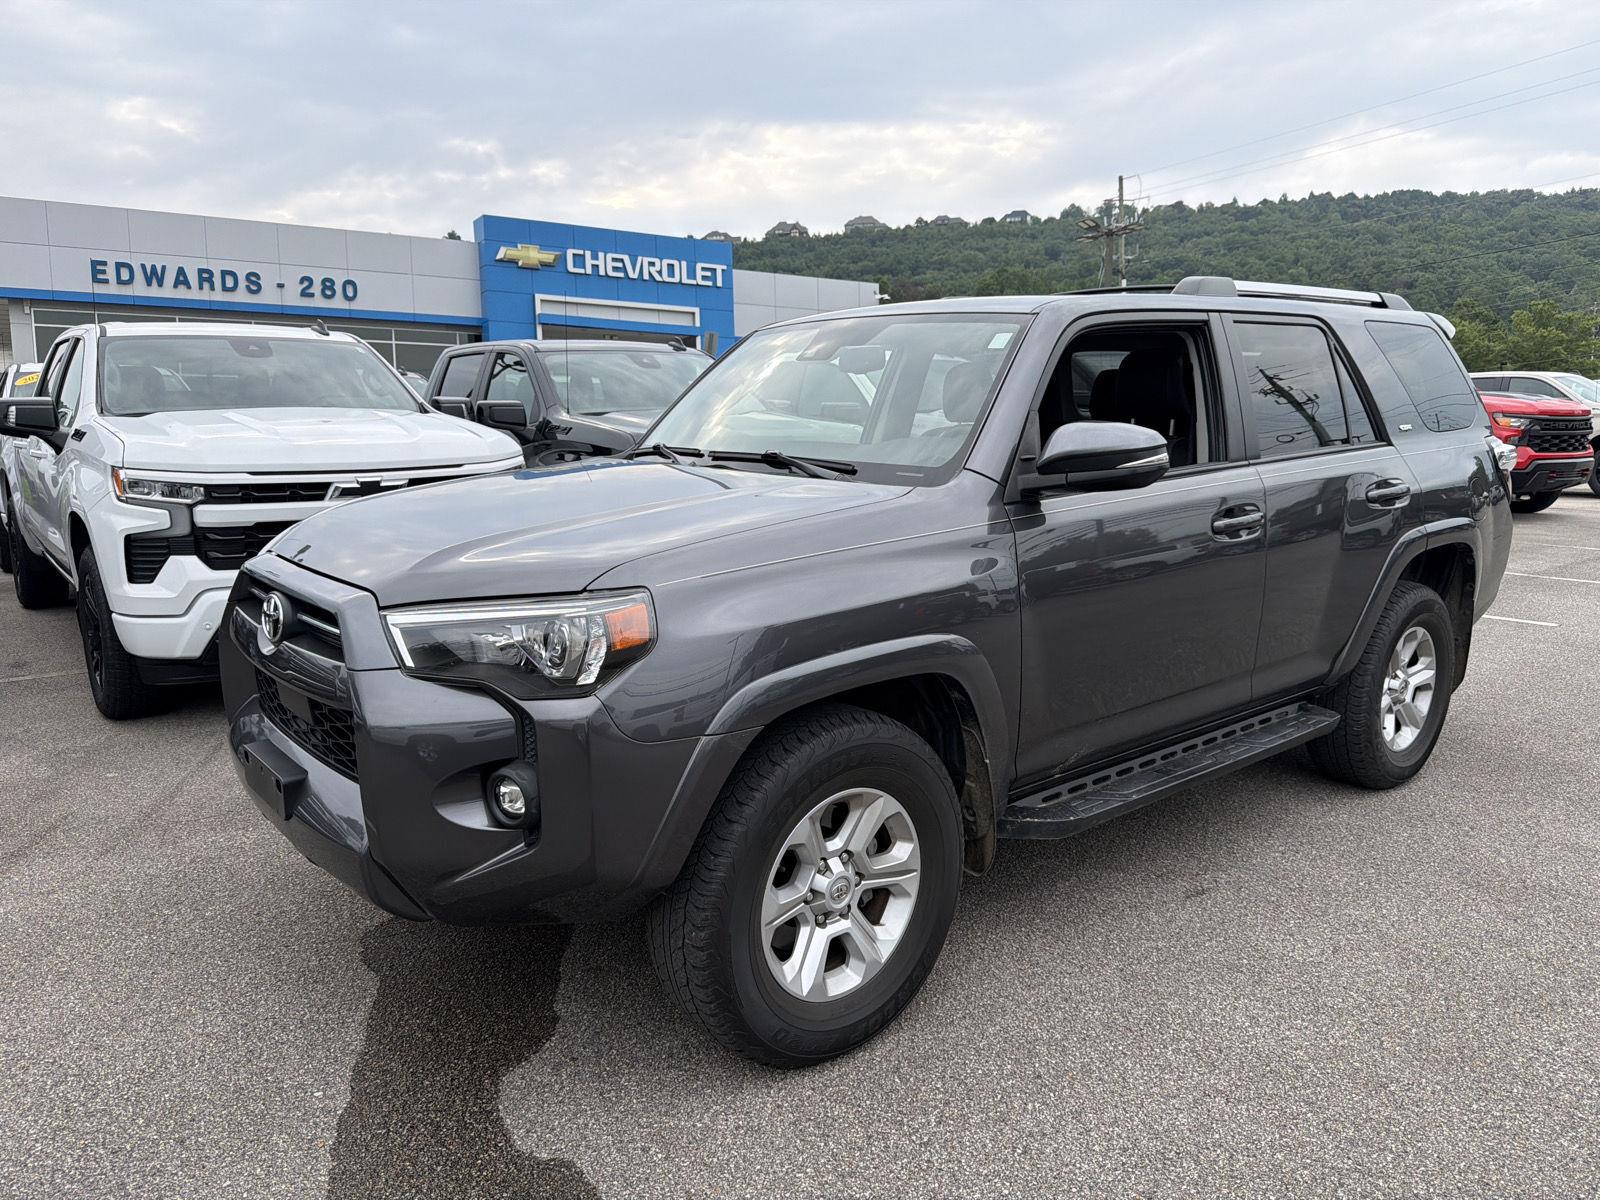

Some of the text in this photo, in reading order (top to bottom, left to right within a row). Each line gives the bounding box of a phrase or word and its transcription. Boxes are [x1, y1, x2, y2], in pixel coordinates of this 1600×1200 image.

[90, 259, 263, 295] EDWARDS
[299, 275, 359, 301] 280
[566, 248, 727, 288] CHEVROLET
